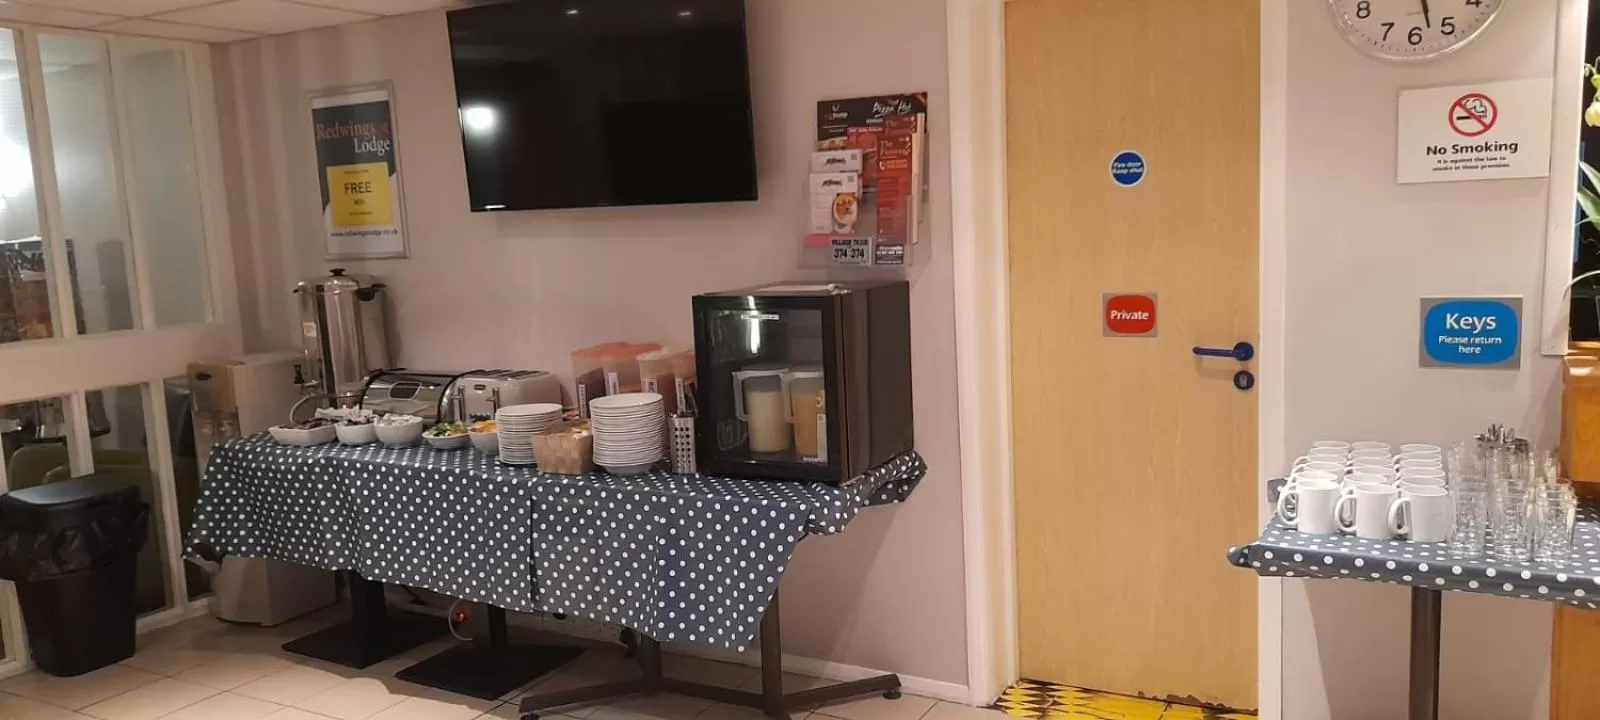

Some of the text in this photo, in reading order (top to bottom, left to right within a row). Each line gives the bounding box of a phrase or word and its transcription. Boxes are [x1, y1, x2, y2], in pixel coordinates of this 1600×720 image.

[1356, 0, 1371, 19] 8
[1381, 22, 1395, 41] 7
[1440, 17, 1456, 35] 5
[1407, 27, 1423, 45] 6
[872, 102, 895, 114] Pizza
[316, 121, 376, 141] Redwings
[354, 137, 391, 156] Lodge
[1426, 141, 1519, 157] No Smoking
[344, 181, 372, 195] FREE
[834, 247, 848, 258] 374
[850, 247, 865, 258] 374
[1110, 309, 1150, 320] Private
[1445, 312, 1497, 334] Keys
[1438, 335, 1502, 344] Please return
[1458, 345, 1481, 354] here
